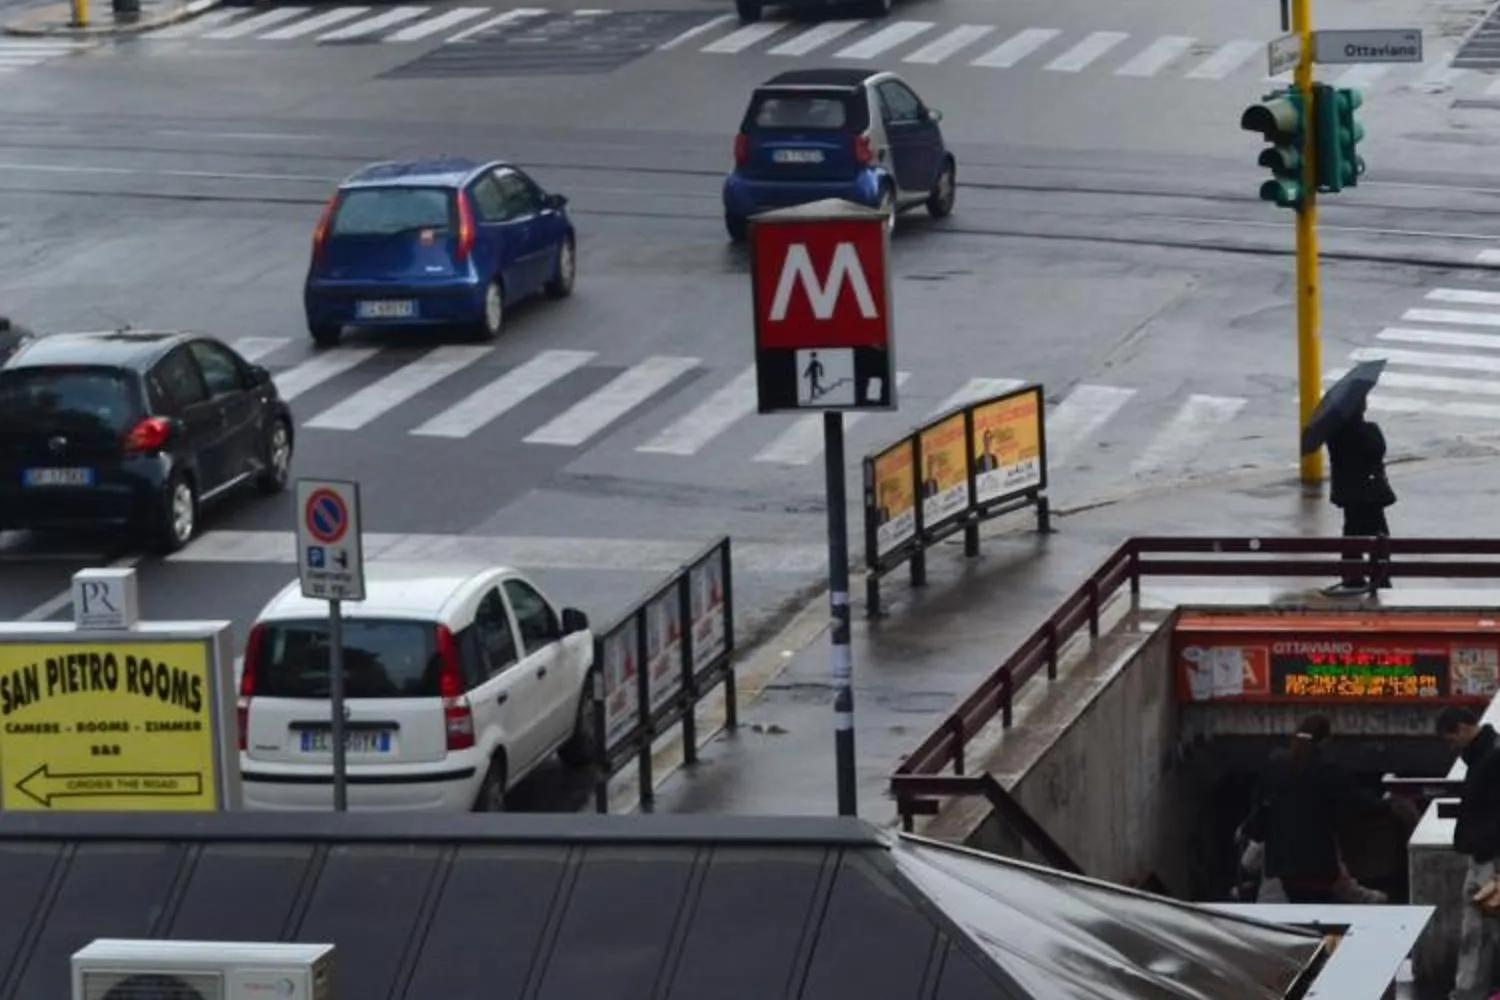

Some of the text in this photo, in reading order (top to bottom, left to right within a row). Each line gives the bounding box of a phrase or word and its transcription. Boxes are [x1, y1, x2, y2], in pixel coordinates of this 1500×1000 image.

[1344, 43, 1418, 57] Ottaviano
[768, 242, 879, 321] M
[1272, 641, 1353, 654] OTTAVIANO
[1, 652, 203, 715] SAN PIETRO ROOMS
[5, 722, 59, 734] CAMERE
[76, 721, 129, 733] ROOMS
[145, 721, 202, 732] ZIMMER
[118, 779, 139, 789] THE
